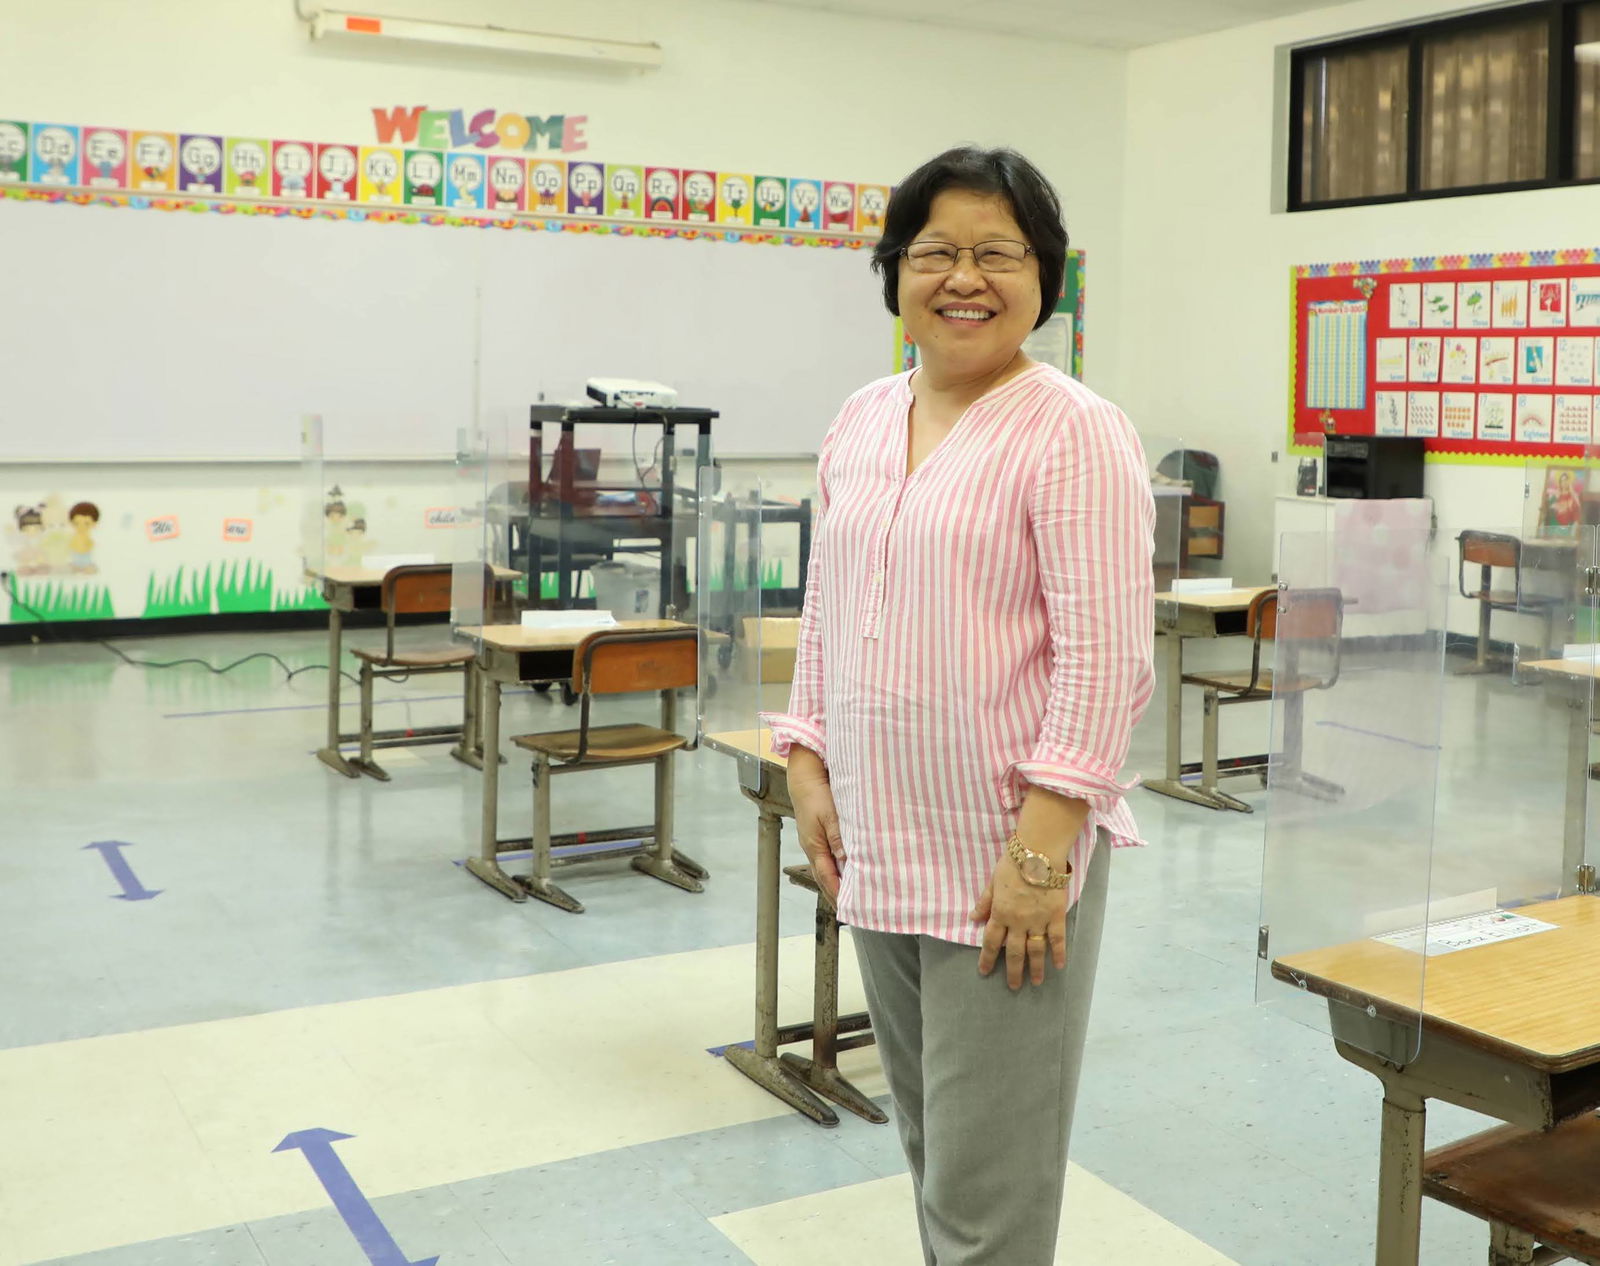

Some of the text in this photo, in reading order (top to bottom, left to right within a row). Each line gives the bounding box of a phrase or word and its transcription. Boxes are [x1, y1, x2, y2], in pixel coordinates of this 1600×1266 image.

[371, 105, 588, 153] WELCOME
[369, 160, 392, 177] Kk
[455, 165, 478, 182] Mm
[496, 167, 518, 185] Nn
[535, 170, 558, 188] Oo
[575, 172, 598, 196] Pp
[613, 175, 636, 199] Qq
[651, 178, 671, 195] Rr
[689, 181, 710, 198] Ss
[726, 183, 744, 201] Tt
[760, 186, 780, 203] Uu
[795, 188, 816, 206] Vv
